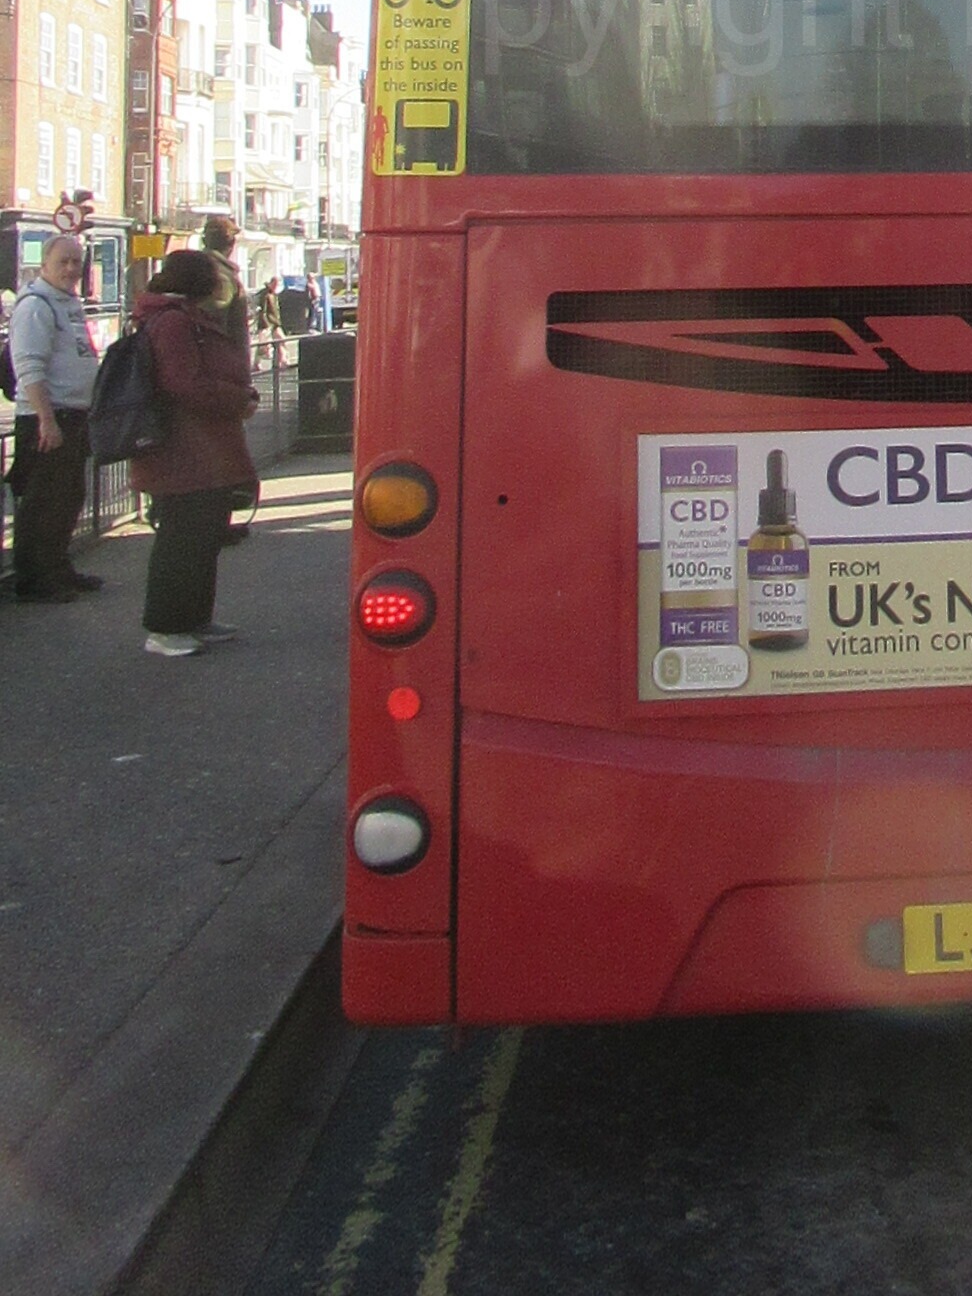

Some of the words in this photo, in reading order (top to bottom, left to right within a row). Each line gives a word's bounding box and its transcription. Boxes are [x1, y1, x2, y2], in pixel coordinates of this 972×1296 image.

[393, 14, 451, 29] Beware
[385, 36, 401, 50] of
[404, 38, 460, 54] passing
[380, 57, 404, 71] this
[411, 57, 436, 71] bus
[443, 59, 464, 72] on
[383, 78, 407, 92] the
[412, 78, 458, 92] inside
[665, 474, 732, 485] VITABIOTICS
[670, 499, 729, 523] CBD
[666, 562, 732, 581] 1000mg
[829, 561, 880, 577] FROM
[762, 583, 796, 597] CBD
[828, 580, 933, 628] UK's
[670, 621, 694, 635] THC
[701, 620, 729, 634] FREE
[827, 629, 920, 656] vitamin
